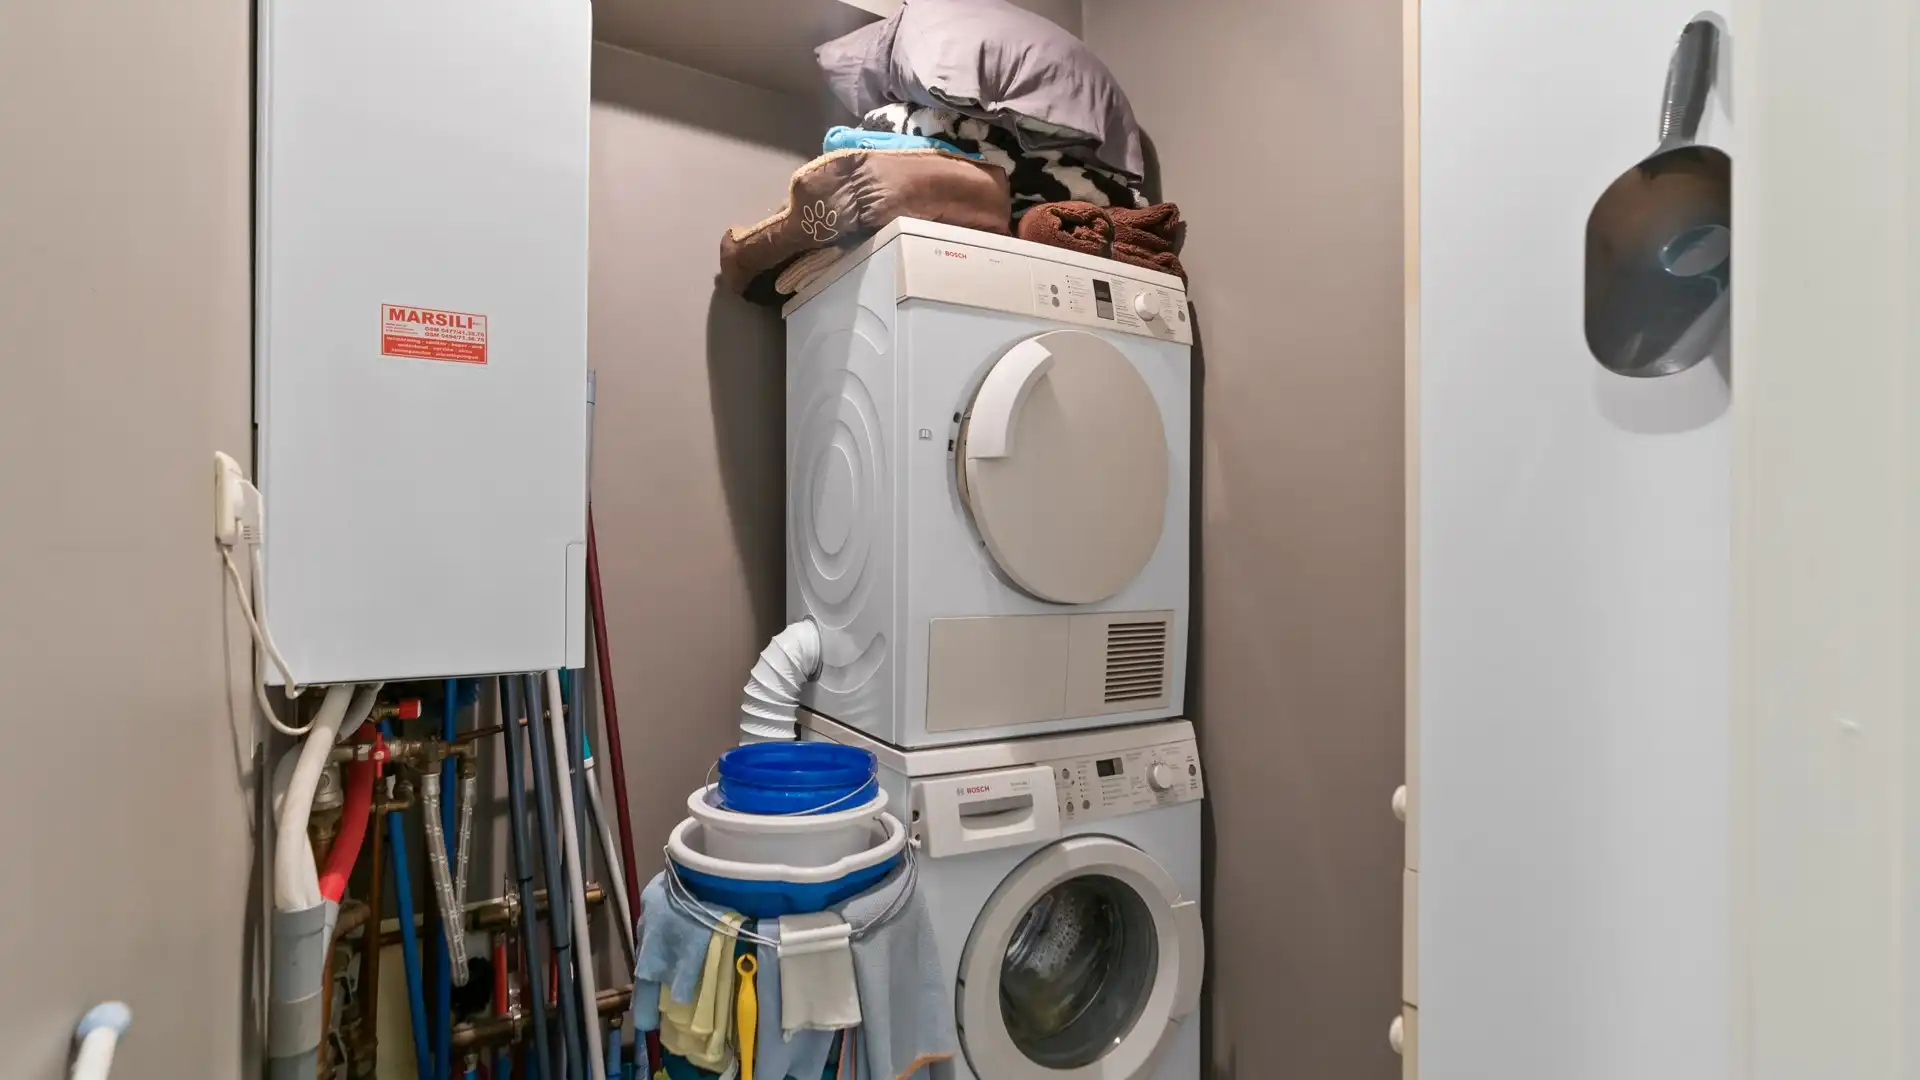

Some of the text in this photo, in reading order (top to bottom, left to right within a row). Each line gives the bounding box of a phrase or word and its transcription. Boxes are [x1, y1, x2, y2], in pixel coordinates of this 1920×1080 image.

[944, 250, 967, 260] BOSCH
[389, 307, 473, 329] MARSILI
[966, 785, 990, 794] BOSCH
